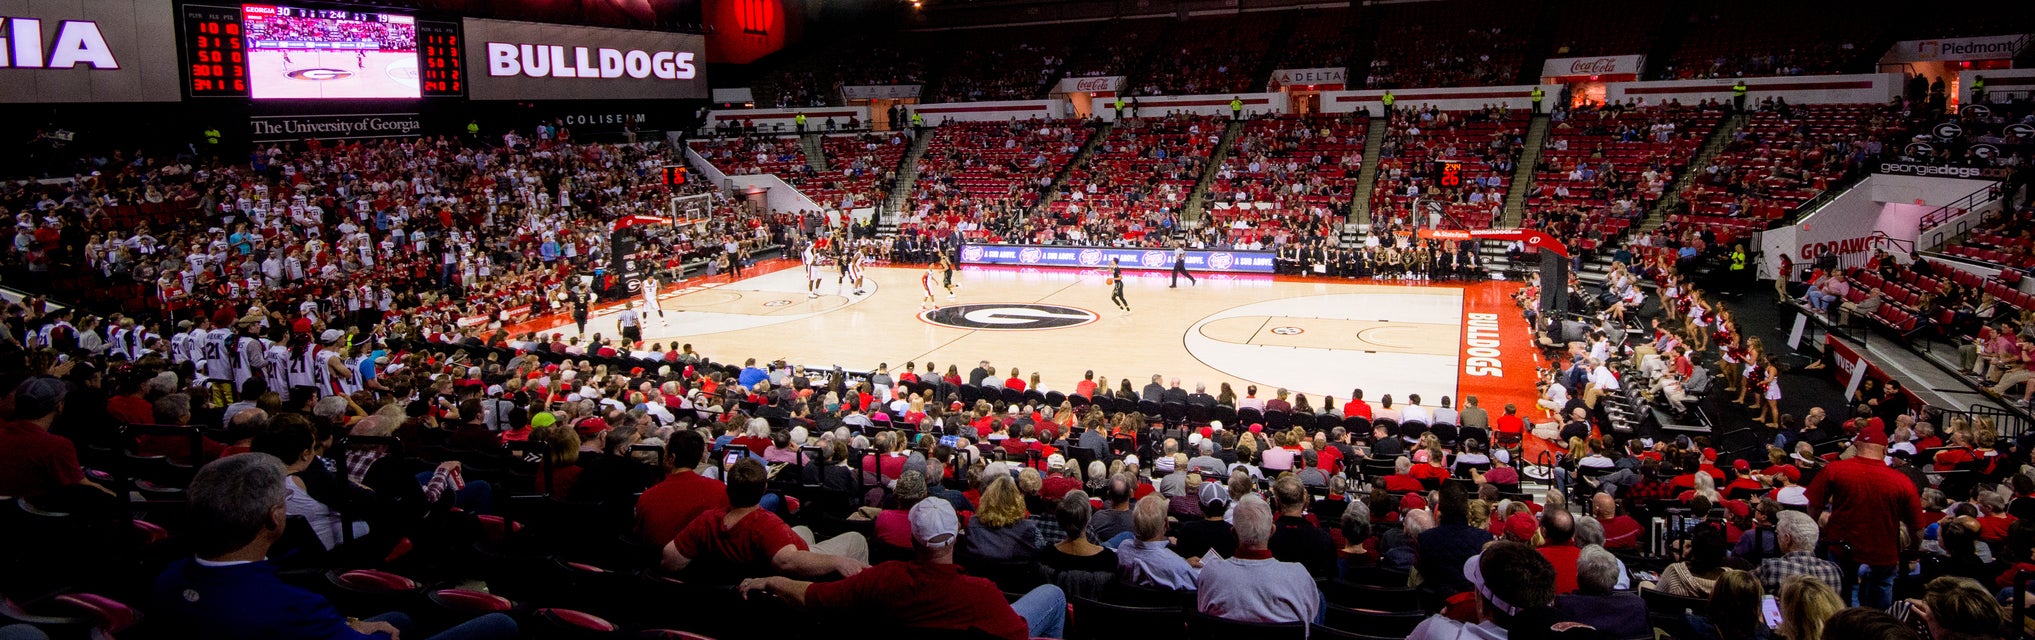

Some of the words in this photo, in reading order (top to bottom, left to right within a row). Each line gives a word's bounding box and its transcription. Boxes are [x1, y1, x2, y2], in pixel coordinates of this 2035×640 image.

[246, 6, 275, 14] GEORGIA
[276, 7, 290, 16] 30
[330, 11, 346, 19] 2:44
[378, 14, 388, 22] 19
[0, 16, 121, 70] IA
[198, 36, 208, 48] 3
[214, 38, 220, 48] 1
[230, 38, 240, 49] 5
[429, 35, 433, 44] 1
[438, 36, 442, 44] 1
[449, 36, 456, 45] 2
[428, 46, 434, 56] 3
[451, 48, 457, 57] 3
[1942, 41, 2012, 54] Piedmont
[199, 51, 208, 62] 5
[212, 51, 221, 62] 0
[232, 52, 241, 62] 0
[486, 42, 696, 80] BULLDOGS
[428, 58, 435, 68] 5
[437, 58, 444, 68] 0
[452, 58, 458, 67] 7
[193, 64, 210, 76] 30
[213, 65, 223, 76] 0
[234, 66, 242, 77] 3
[427, 70, 436, 78] 11
[441, 70, 445, 79] 1
[452, 70, 459, 80] 2
[1296, 72, 1341, 81] DELTA
[194, 79, 212, 90] 34
[219, 80, 224, 90] 1
[234, 80, 244, 90] 6
[425, 81, 437, 91] 24
[439, 82, 446, 91] 0
[453, 82, 459, 91] 2
[250, 120, 282, 134] The
[284, 119, 352, 135] University
[354, 118, 369, 131] of
[370, 118, 420, 133] Georgia
[1445, 163, 1461, 171] 2:44
[1441, 171, 1459, 186] 26
[1802, 242, 1824, 260] GO
[1253, 258, 1273, 266] ABOVE.
[172, 343, 181, 354] 21
[1466, 312, 1504, 377] BULLDOGS
[206, 342, 220, 359] 21
[290, 355, 305, 373] 21
[268, 362, 277, 378] 21
